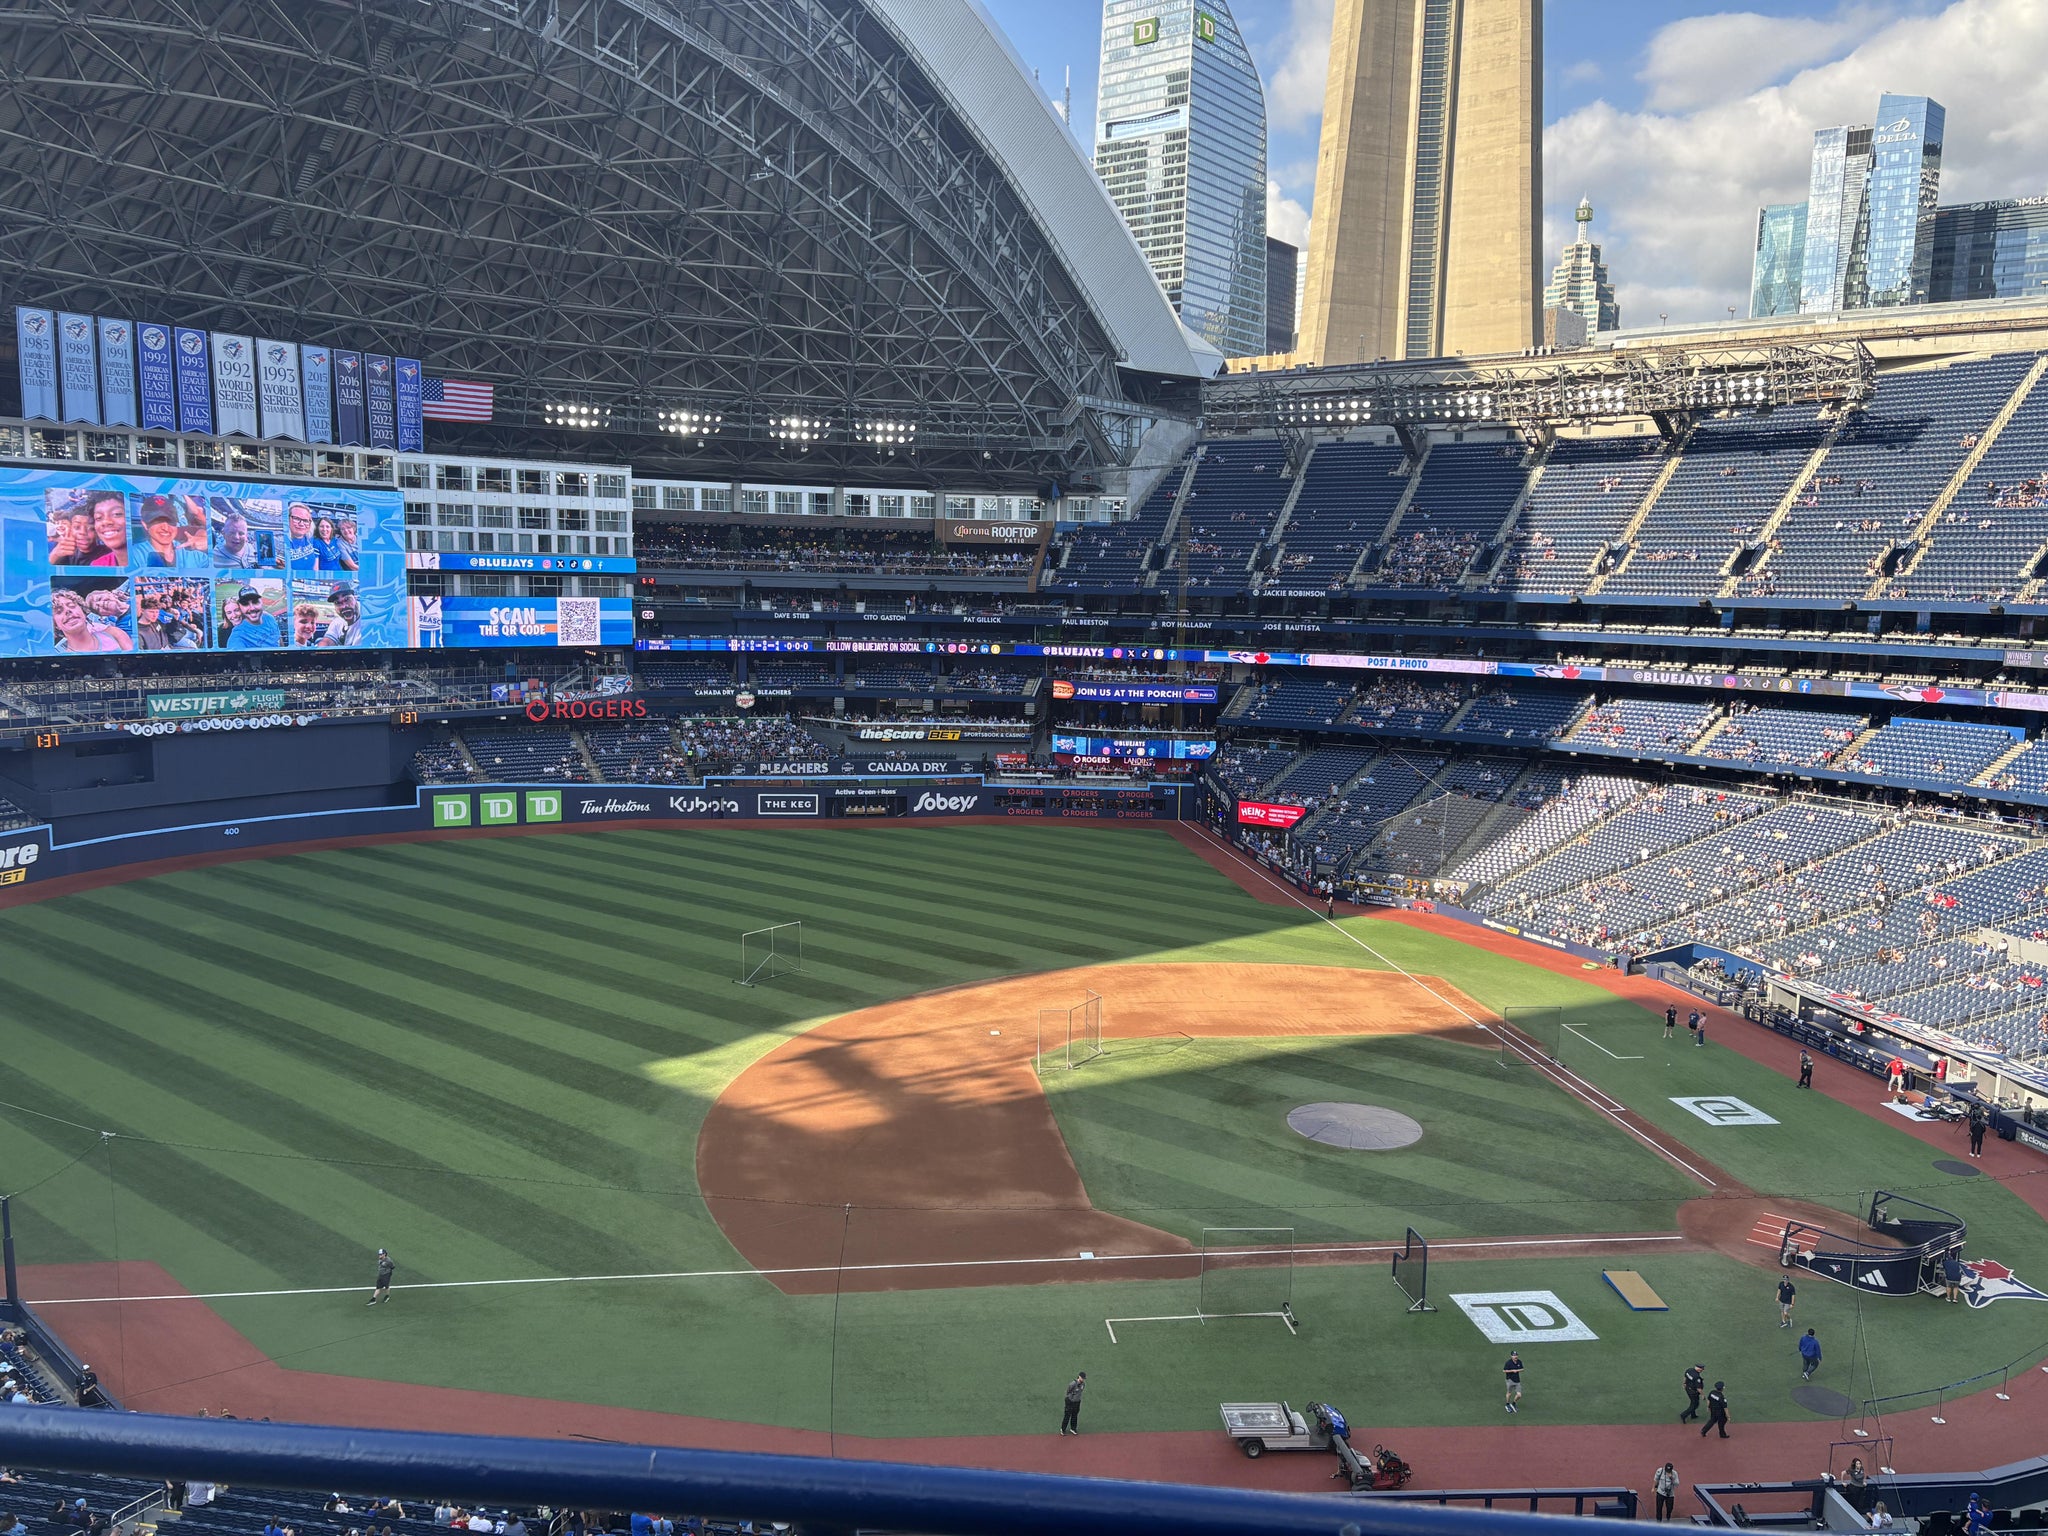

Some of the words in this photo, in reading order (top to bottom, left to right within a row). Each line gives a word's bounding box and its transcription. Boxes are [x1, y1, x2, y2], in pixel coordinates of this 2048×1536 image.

[1136, 23, 1153, 40] TD
[1202, 17, 1214, 37] TD
[1877, 132, 1918, 144] DELTA
[24, 337, 50, 351] 1985
[65, 342, 90, 355] 1989
[24, 351, 51, 360] AMERICAN
[106, 347, 128, 359] 1991
[143, 351, 168, 364] 1992
[24, 359, 52, 369] LEAGUE
[65, 357, 92, 365] AMERICAN
[105, 361, 131, 370] AMERICAN
[181, 356, 205, 368] 1993
[24, 368, 52, 379] EAST
[65, 364, 93, 373] LEAGUE
[105, 368, 132, 377] LEAGUE
[181, 370, 206, 378] AMERICAN
[218, 360, 251, 378] 1992
[66, 372, 93, 383] EAST
[144, 372, 169, 381] LEAGUE
[263, 366, 296, 383] 1993
[25, 379, 53, 388] CHAMPS
[106, 376, 132, 388] EAST
[145, 380, 170, 391] EAST
[181, 376, 207, 385] LEAGUE
[218, 379, 253, 392] WORLD
[339, 375, 360, 387] 2016
[66, 383, 94, 392] CHAMPS
[182, 384, 207, 395] EAST
[263, 384, 298, 396] WORLD
[371, 386, 390, 396] 2016
[400, 383, 419, 393] 2025
[145, 391, 171, 399] CHAMPS
[182, 395, 208, 403] CHAMPS
[219, 390, 254, 403] SERIES
[340, 388, 361, 399] ALDS
[219, 401, 255, 411] CHAMPIONS
[263, 395, 299, 407] SERIES
[371, 400, 391, 411] 2020
[146, 404, 172, 415] ALCS
[184, 407, 209, 418] ALCS
[264, 405, 300, 415] CHAMPIONS
[400, 408, 420, 417] EAST
[146, 414, 172, 423] CHAMPS
[184, 418, 210, 427] CHAMPS
[372, 415, 393, 426] 2022
[402, 428, 420, 438] ALCS
[953, 525, 990, 538] Corona
[991, 526, 1038, 538] ROOFTOP
[469, 558, 534, 568] @BLUEJAYS
[1262, 589, 1287, 597] JACKIE
[1288, 590, 1326, 598] ROBINSON
[489, 607, 536, 626] SCAN
[478, 625, 499, 636] THE
[501, 625, 518, 637] QR
[519, 624, 546, 636] CODE
[1177, 621, 1213, 629] HALLADAY
[1263, 622, 1281, 631] JOSÉ
[1285, 624, 1321, 632] BAUTISTA
[826, 642, 850, 651] FOLLOW
[852, 642, 888, 652] @BLUEJAYS
[890, 643, 899, 651] ON
[900, 643, 921, 652] SOCIAL
[1043, 646, 1104, 657] @BLUEJAYS
[2006, 651, 2032, 661] WINNER
[1367, 658, 1386, 668] POST
[1388, 659, 1397, 667] A
[1399, 659, 1429, 669] PHOTO
[1633, 671, 1712, 686] @BLUEJAYS
[251, 693, 285, 702] FLIGHT
[1077, 688, 1097, 696] JOIN
[1099, 688, 1111, 696] US
[1114, 689, 1125, 697] AT
[1128, 689, 1145, 697] THE
[1147, 690, 1182, 698] PORCH!
[150, 696, 229, 714] WESTJET
[555, 699, 647, 718] ROGERS
[132, 722, 175, 735] VOTE
[201, 718, 242, 730] BLUE
[251, 714, 292, 729] JAYS
[859, 728, 925, 742] theScore
[930, 731, 960, 740] BET
[1081, 756, 1110, 764] ROGERS
[759, 763, 829, 774] BLEACHERS
[867, 762, 920, 772] CANADA
[1015, 788, 1044, 796] ROGERS
[1126, 791, 1154, 799] ROGERS
[529, 796, 558, 816] TD
[580, 799, 603, 815] Tim
[602, 798, 651, 815] Hortons
[670, 796, 739, 813] Kubota
[764, 800, 782, 808] THE
[790, 800, 812, 808] KEG
[914, 791, 978, 812] Sobeys
[437, 800, 467, 820] TD
[484, 798, 513, 818] TD
[1015, 808, 1043, 816] ROGERS
[1070, 809, 1098, 817] ROGERS
[1241, 807, 1266, 818] HEINZ
[223, 826, 240, 836] 400
[1692, 1099, 1752, 1122] TD
[1470, 1301, 1569, 1332] TD
